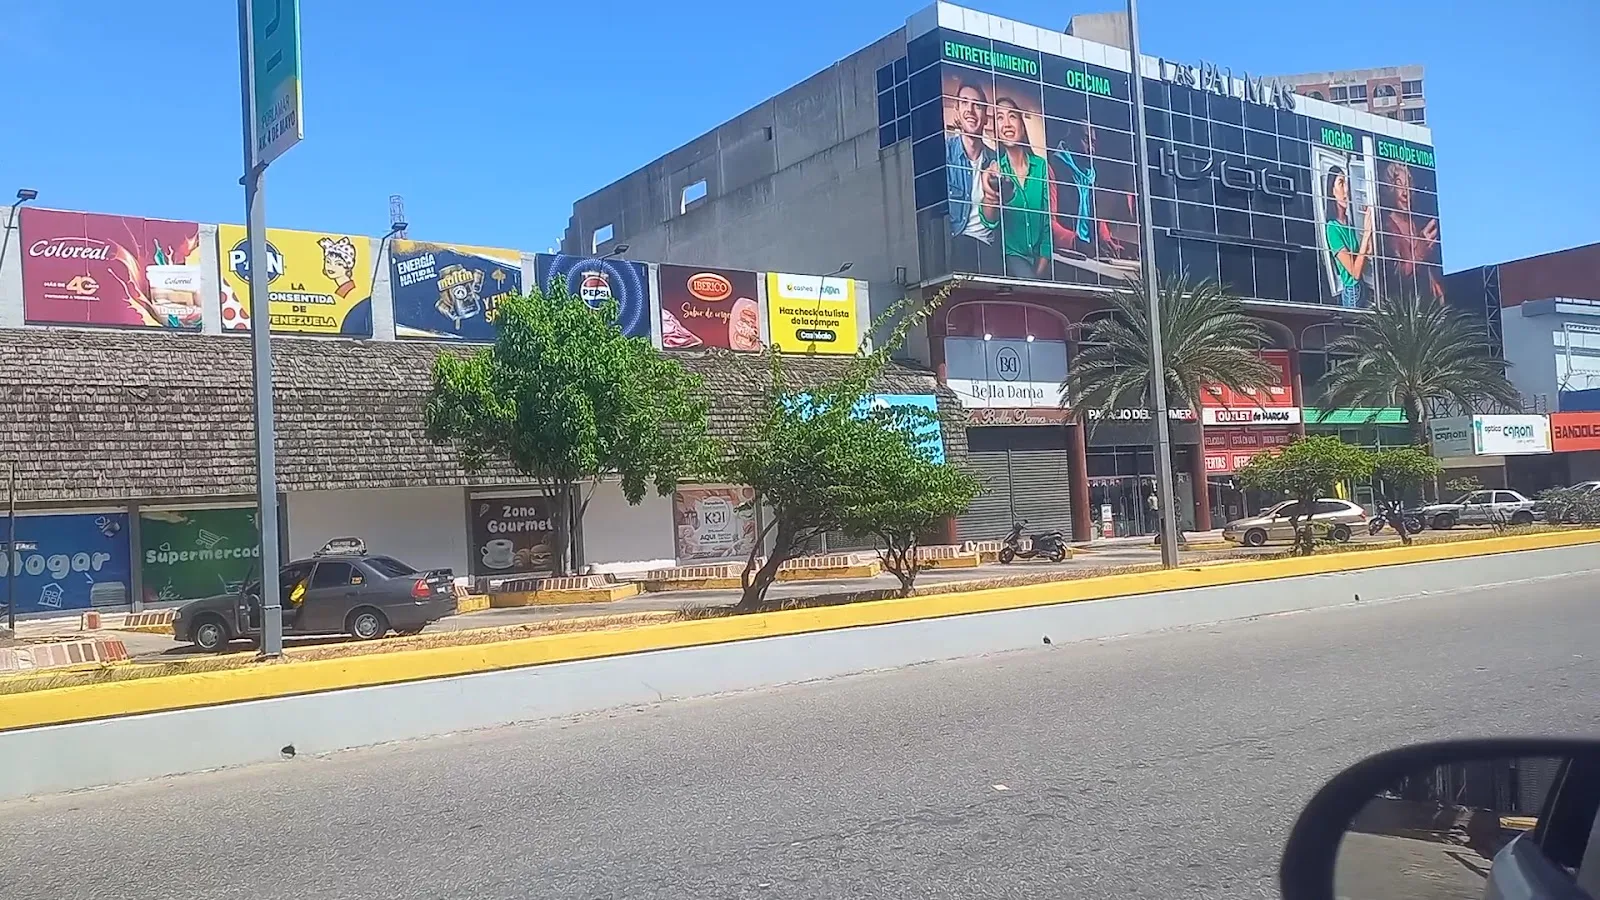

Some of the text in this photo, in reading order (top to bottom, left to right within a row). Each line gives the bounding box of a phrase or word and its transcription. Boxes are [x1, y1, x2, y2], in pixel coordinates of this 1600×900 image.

[944, 41, 1037, 76] ENTRETENIMIENTO
[1066, 69, 1111, 96] OFICINA
[1158, 57, 1297, 112] LAS PALMAS
[1321, 128, 1353, 150] HOGAR
[1378, 141, 1434, 167] ESTILO DE VIDA
[29, 240, 110, 261] Coloreal
[397, 252, 436, 275] ENERGÍA
[291, 283, 305, 291] LA
[582, 288, 610, 298] PEPSI
[268, 292, 336, 304] ONSENTIDA
[292, 305, 307, 313] DE
[779, 306, 794, 315] Haz
[795, 308, 818, 317] check
[825, 309, 833, 317] tu
[833, 309, 850, 318] lista
[268, 315, 337, 327] VENEZUELA
[791, 317, 840, 328] de la compra
[971, 385, 1044, 399] Bella Dama
[1218, 411, 1251, 421] OUTLET
[1262, 411, 1290, 421] MARCAS
[502, 506, 535, 517] Zona
[487, 518, 553, 533] Gourmet
[146, 544, 260, 565] Supermercad
